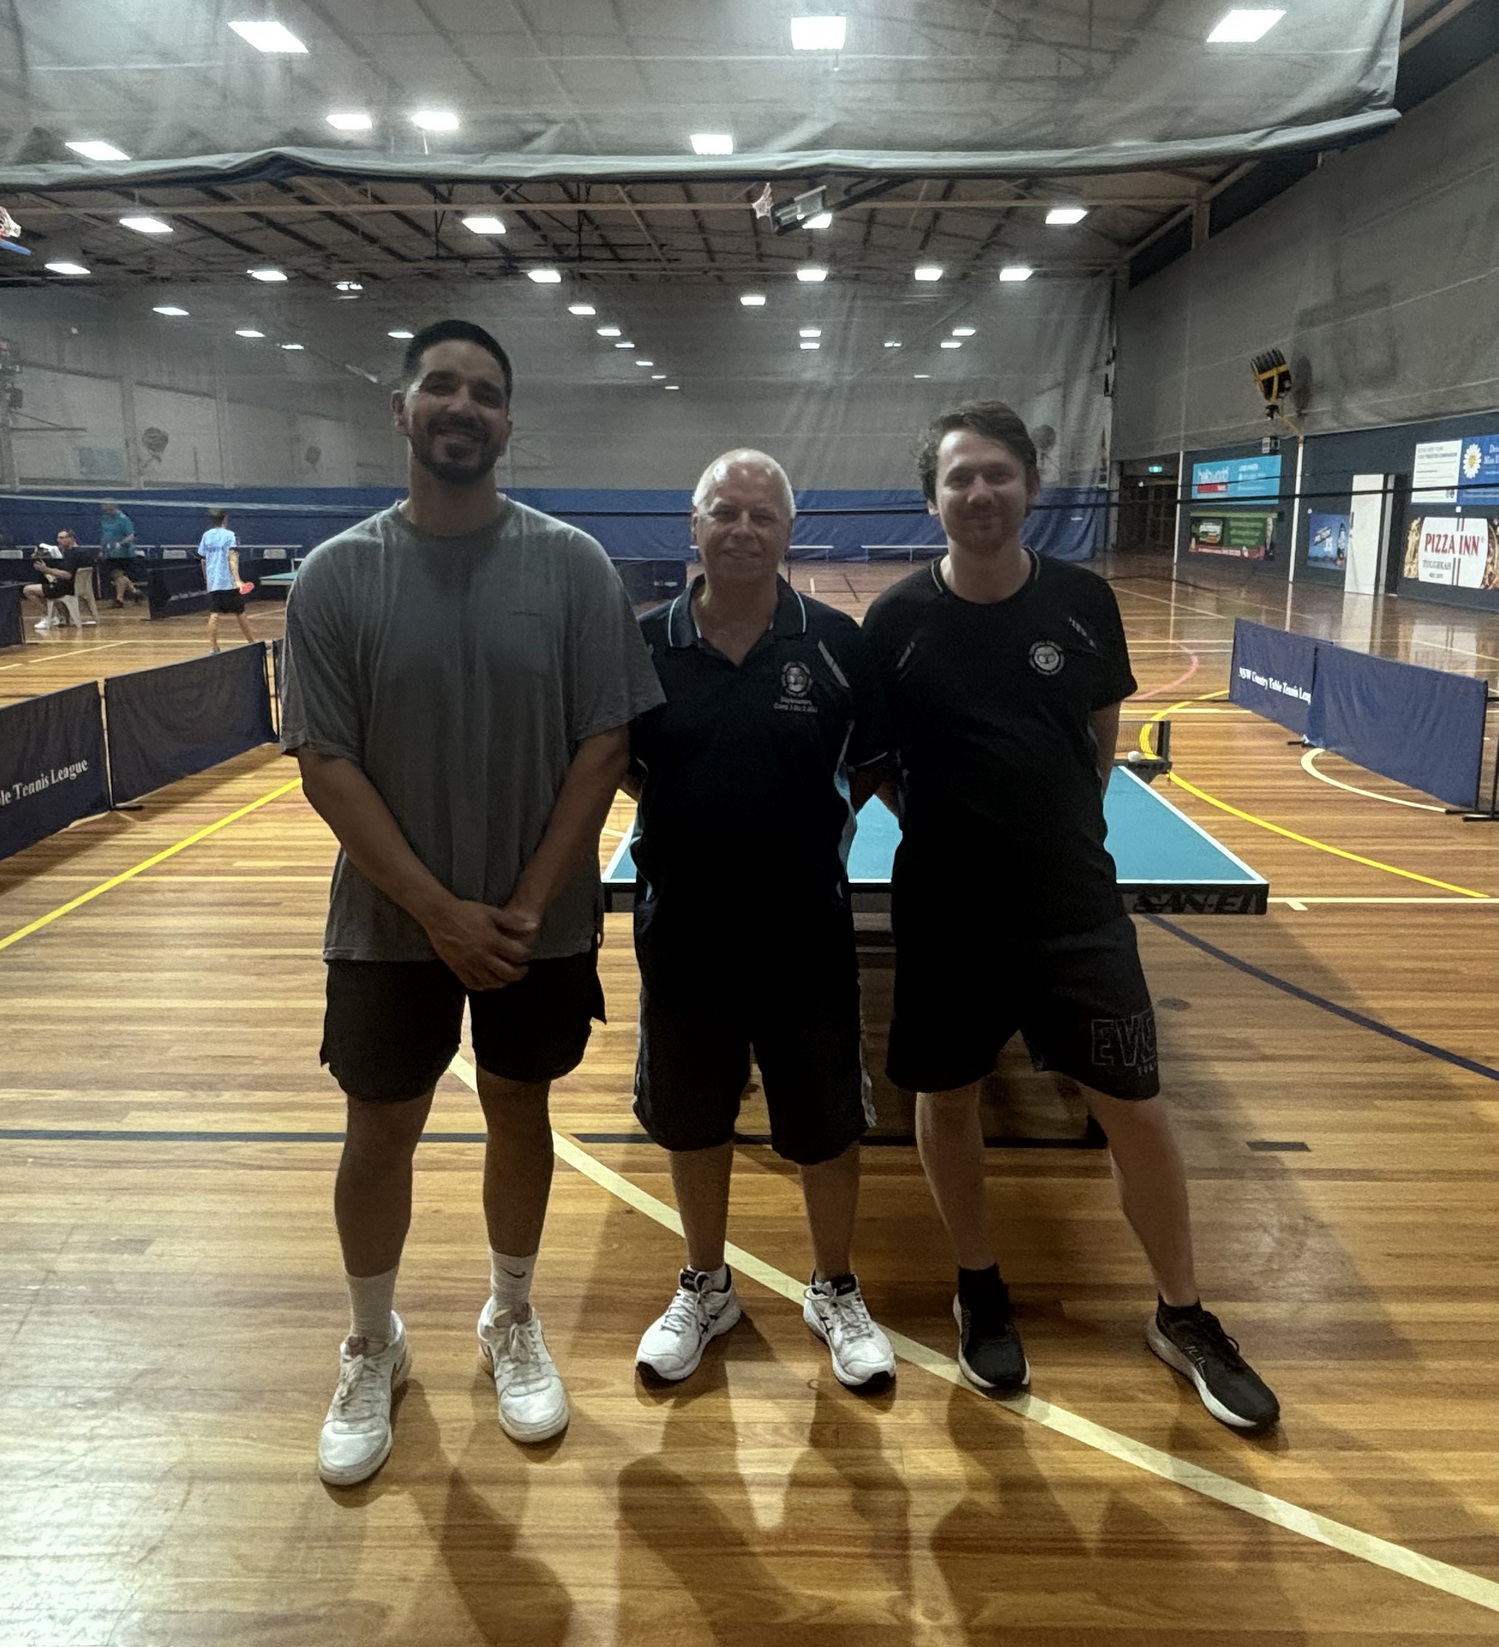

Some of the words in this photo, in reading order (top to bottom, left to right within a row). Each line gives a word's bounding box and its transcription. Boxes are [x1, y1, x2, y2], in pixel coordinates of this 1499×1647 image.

[1424, 533, 1456, 555] PIZZA
[1458, 534, 1480, 557] INN
[1252, 671, 1268, 690] Country
[1269, 677, 1282, 692] Table
[1282, 682, 1299, 699] Tennis
[0, 789, 12, 807] le
[12, 773, 50, 800] Tennis
[50, 759, 89, 785] League
